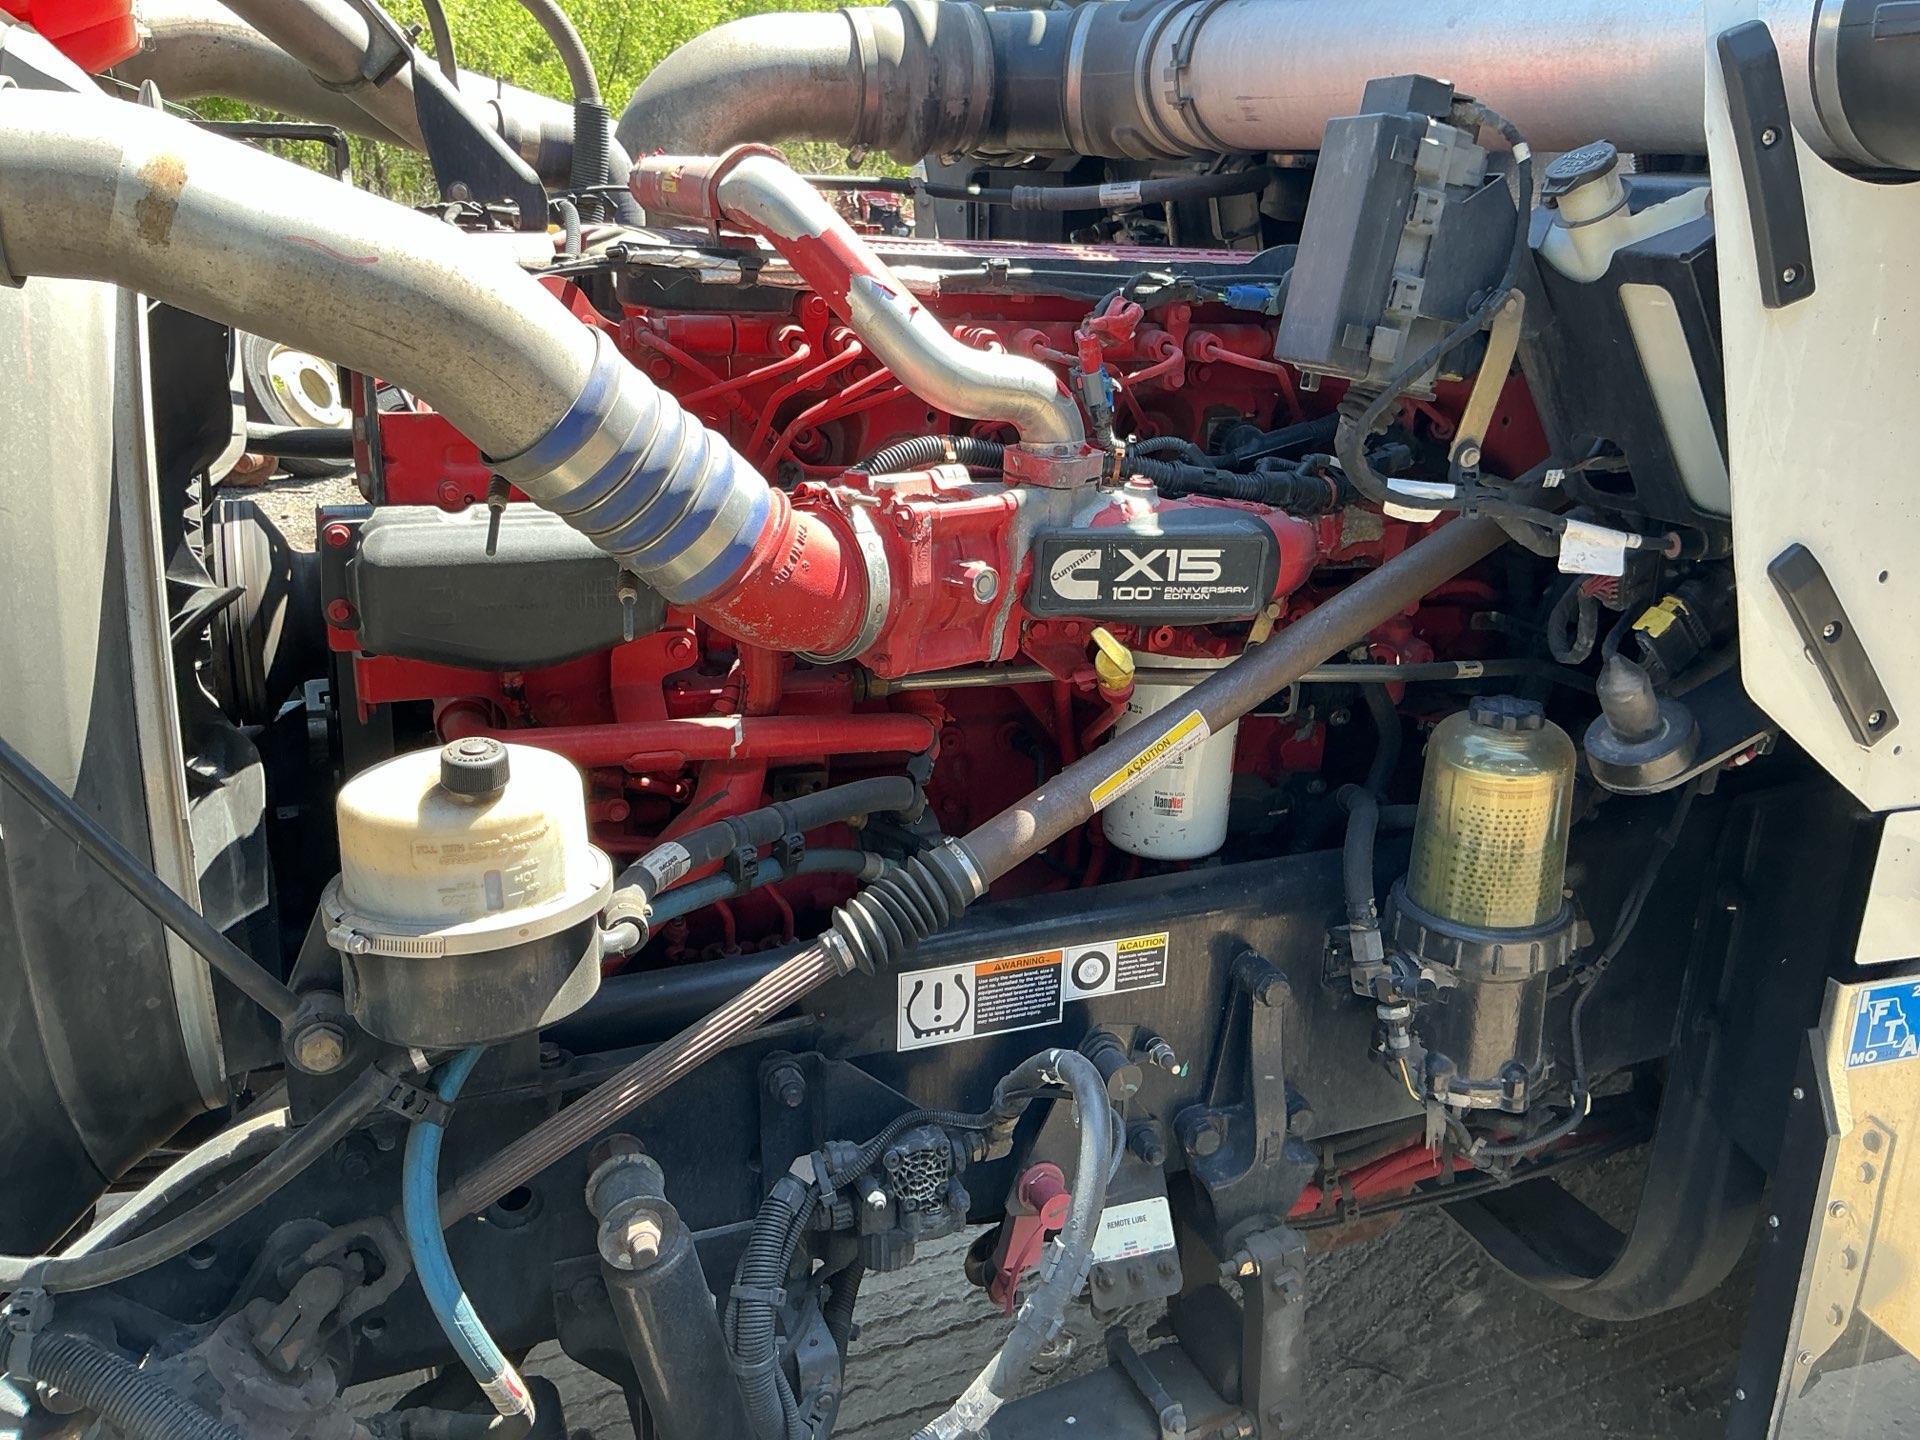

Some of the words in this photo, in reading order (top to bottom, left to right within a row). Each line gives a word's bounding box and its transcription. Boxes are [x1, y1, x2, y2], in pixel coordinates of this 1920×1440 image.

[1051, 549, 1098, 583] Cummins
[1113, 549, 1223, 582] X15
[1163, 586, 1249, 595] ANNIVERSARY
[1163, 592, 1210, 600] EDITION
[1133, 737, 1171, 771] CAUTION
[1126, 937, 1165, 949] CAUTION
[1001, 956, 1045, 970] WARNING
[1860, 991, 1918, 1057] IFTA
[1850, 1049, 1878, 1066] MO
[1106, 1217, 1131, 1230] REMOTE
[1131, 1214, 1148, 1225] LUBE
